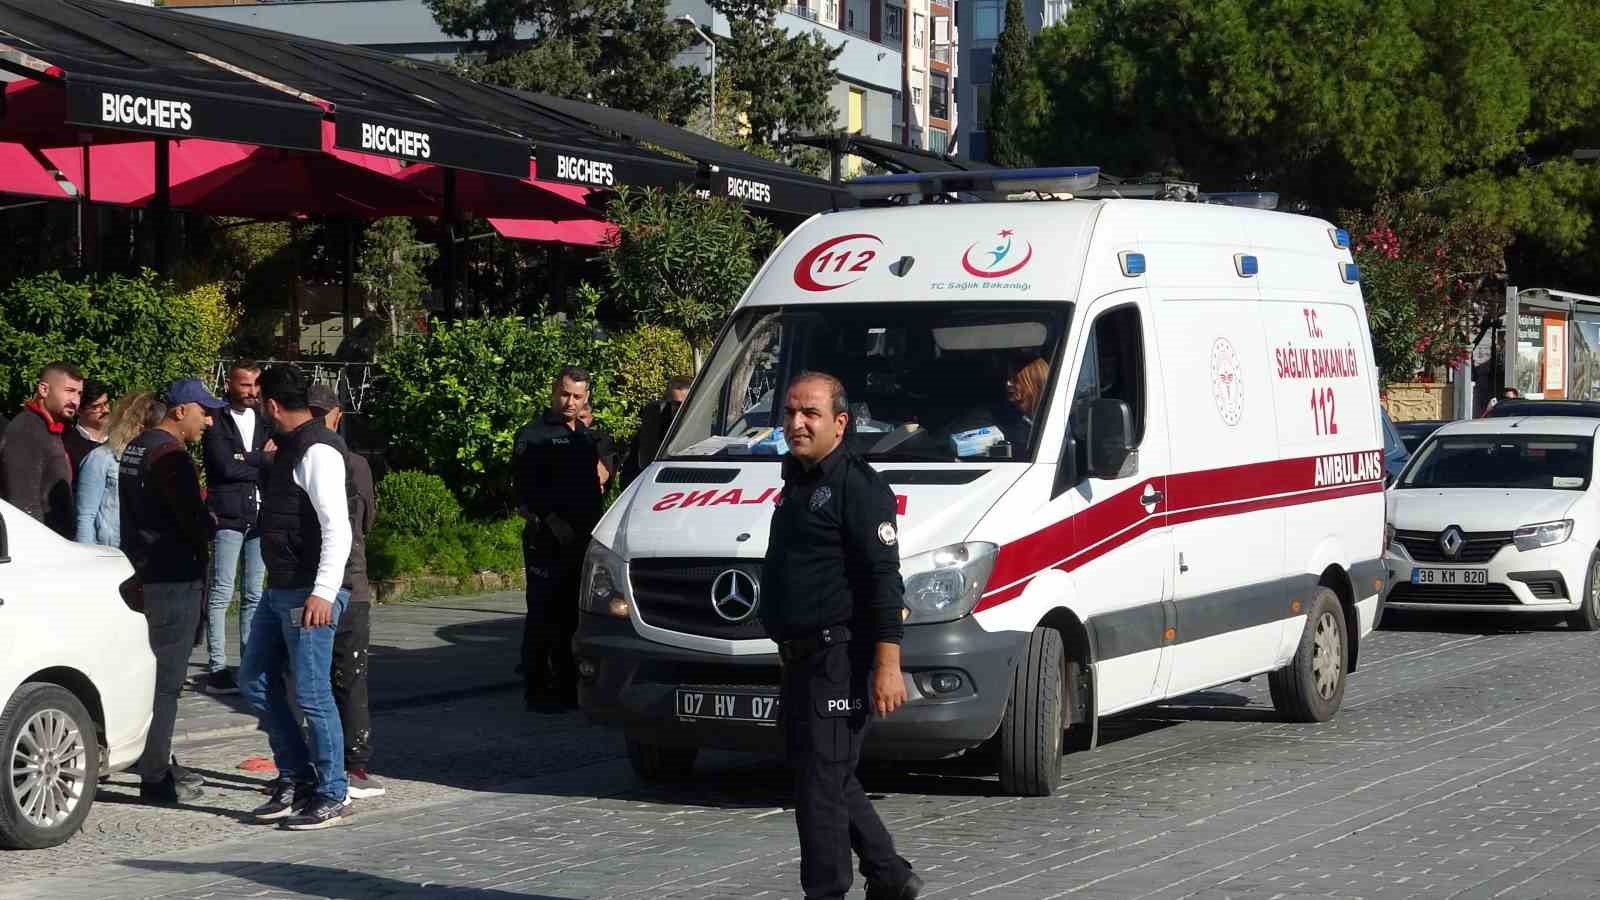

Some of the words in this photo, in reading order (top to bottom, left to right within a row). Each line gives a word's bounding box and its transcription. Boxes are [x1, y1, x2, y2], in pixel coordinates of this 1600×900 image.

[102, 92, 192, 131] BIGCHEFS
[361, 122, 431, 158] BIGCHEFS
[557, 154, 614, 186] BIGCHEFS
[728, 176, 771, 203] BIGCHEFS
[816, 250, 876, 273] 112
[1303, 307, 1324, 339] T.C.
[1275, 340, 1312, 379] SAĞLIK
[1311, 340, 1359, 379] BAKANLIĞI
[1310, 387, 1338, 436] 112
[1314, 451, 1382, 487] AMBULANS
[1419, 570, 1435, 583] 38
[1463, 570, 1486, 584] 820
[684, 693, 704, 715] 07
[715, 694, 736, 717] HV
[752, 696, 780, 719] 07
